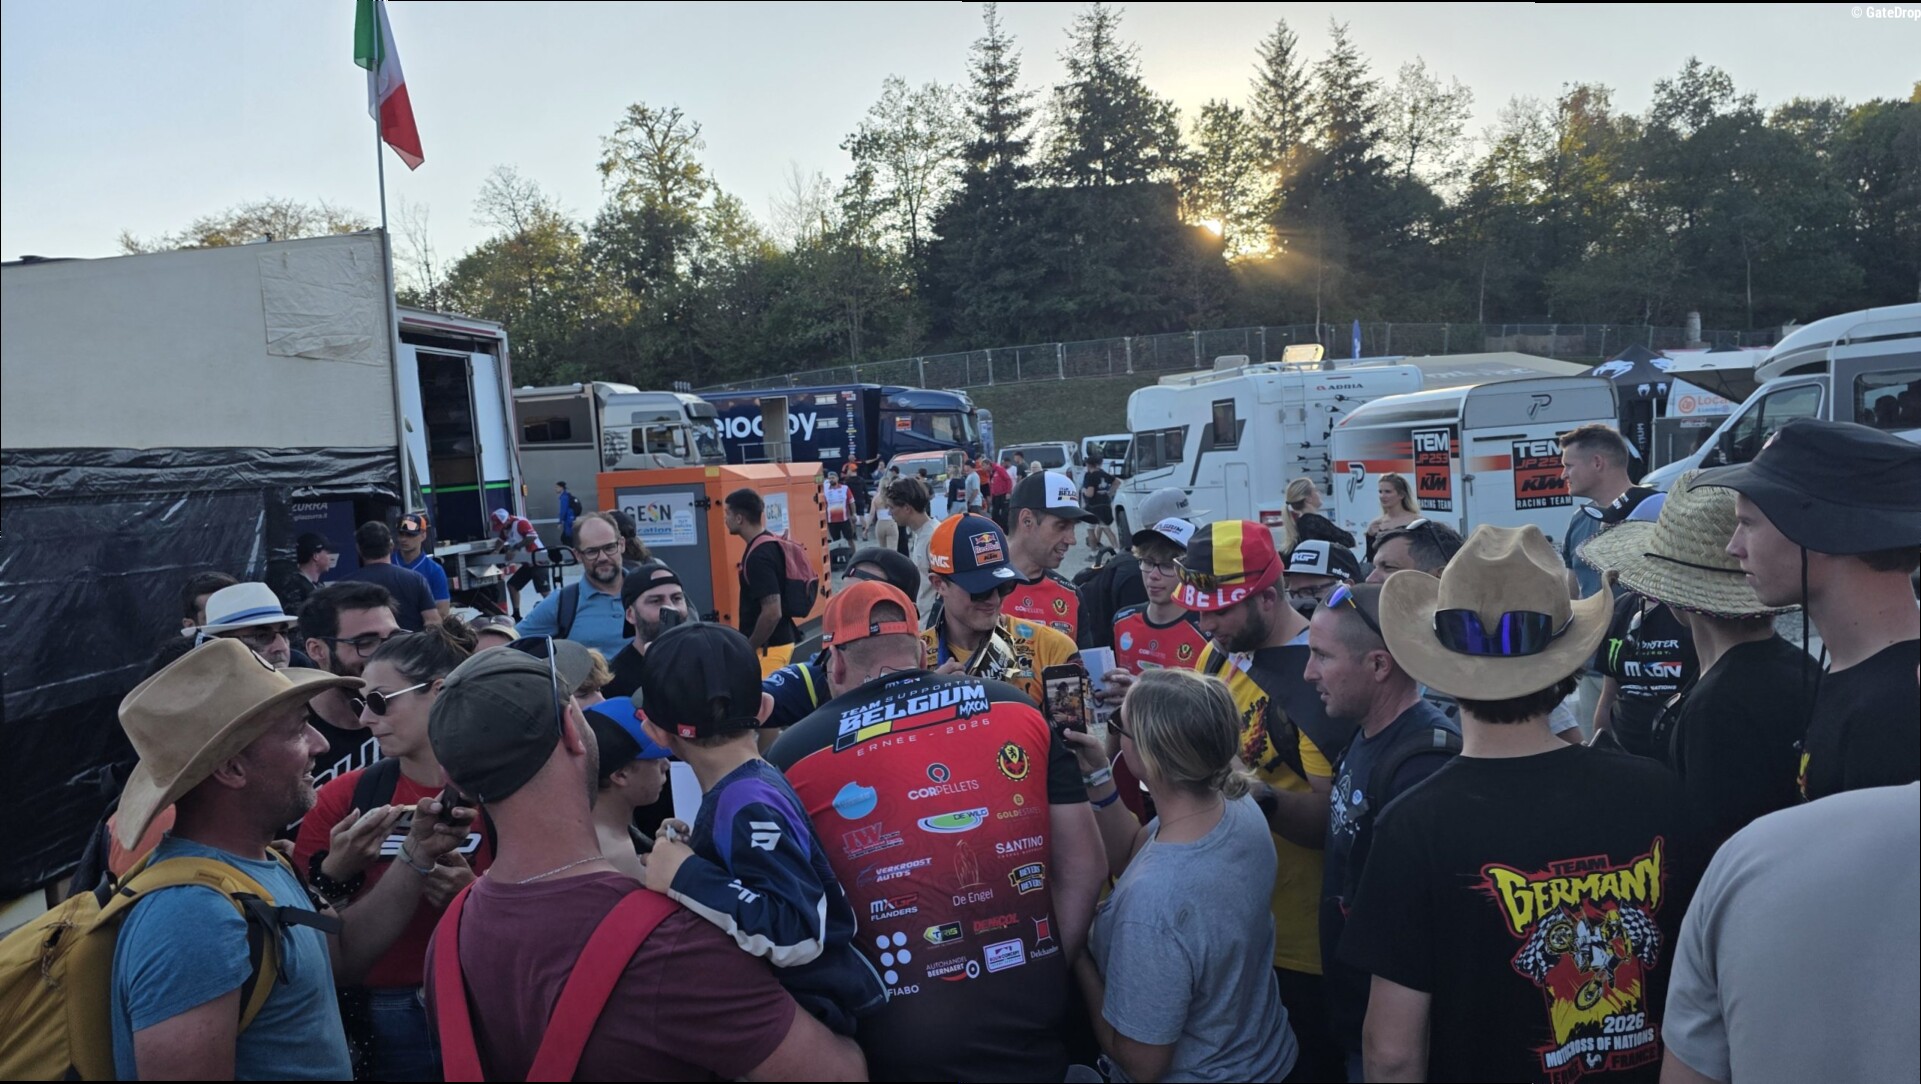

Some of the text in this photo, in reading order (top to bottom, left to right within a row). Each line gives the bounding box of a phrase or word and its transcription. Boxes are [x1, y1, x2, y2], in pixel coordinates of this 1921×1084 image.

[1328, 383, 1364, 391] ADRIA
[1414, 432, 1449, 452] TEM
[1420, 472, 1447, 491] KTM
[1521, 474, 1565, 492] KTM
[1516, 496, 1572, 508] RACING TEAM
[1185, 583, 1254, 608] BELG
[885, 678, 982, 703] SUPPORTER
[838, 684, 985, 736] BELGIUM
[841, 699, 882, 718] TEAM
[945, 717, 991, 735] 2026
[907, 779, 980, 800] CORPELLETS
[995, 835, 1043, 854] SANTINO
[875, 857, 933, 875] VERKROOST
[1551, 855, 1608, 876] TEAM
[876, 869, 911, 883] AUTO'S
[1487, 838, 1662, 934] GERMANY
[952, 887, 994, 907] De Engel
[870, 906, 918, 922] FLANDERS
[926, 955, 968, 971] AUTOHANDEL
[926, 963, 965, 978] BEERNAERT
[887, 984, 920, 997] FIABO
[1603, 1012, 1646, 1035] 2026
[1544, 1026, 1656, 1069] MOTOCROSS OF NATIONS
